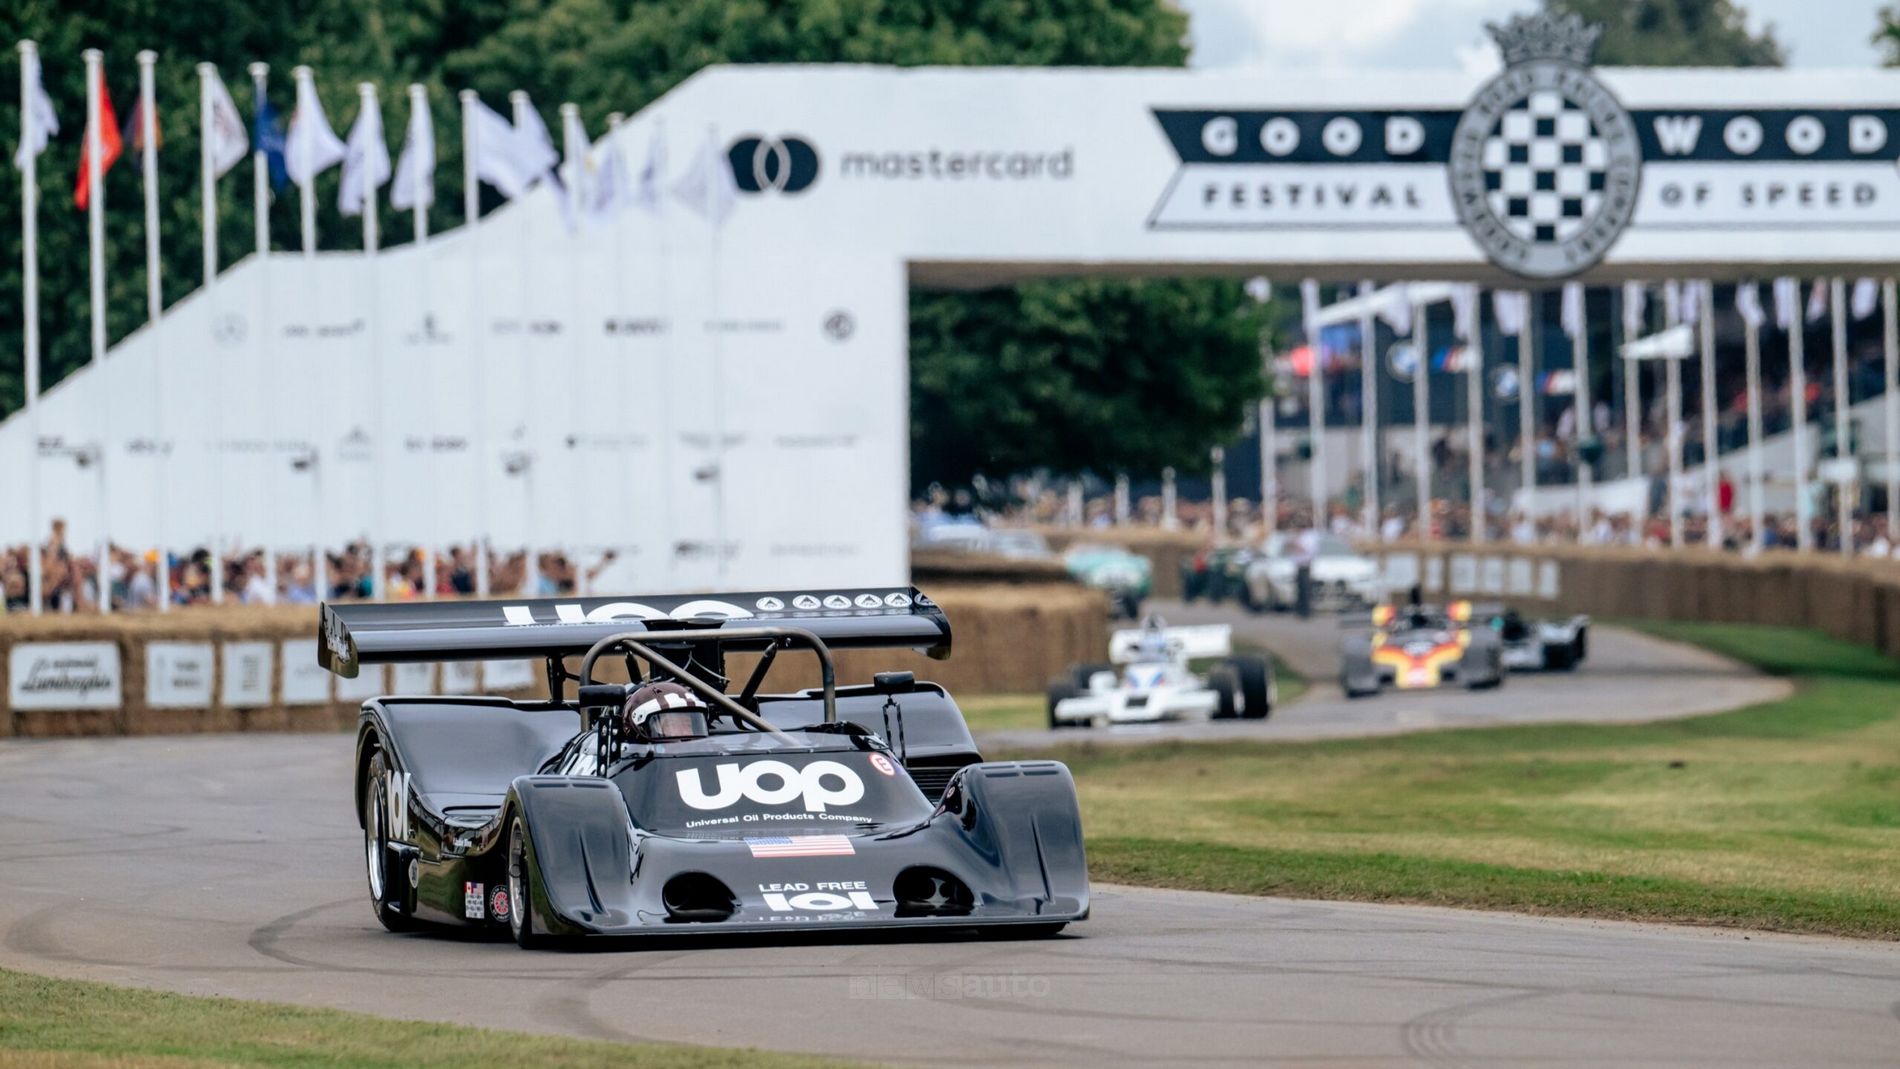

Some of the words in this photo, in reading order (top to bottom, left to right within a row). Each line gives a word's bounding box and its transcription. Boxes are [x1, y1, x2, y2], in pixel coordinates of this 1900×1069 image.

[1201, 114, 1426, 156] GOOD
[1653, 114, 1888, 156] WOOD
[841, 145, 1075, 180] mastercard
[1203, 183, 1423, 210] FESTIVAL
[1660, 183, 1711, 209] OF
[1740, 183, 1878, 209] SPEED
[686, 816, 739, 828] Universal
[743, 814, 759, 822] Oil
[763, 813, 815, 821] Products
[818, 813, 872, 823] Company
[758, 882, 810, 892] LEAD
[816, 881, 868, 891] FREE
